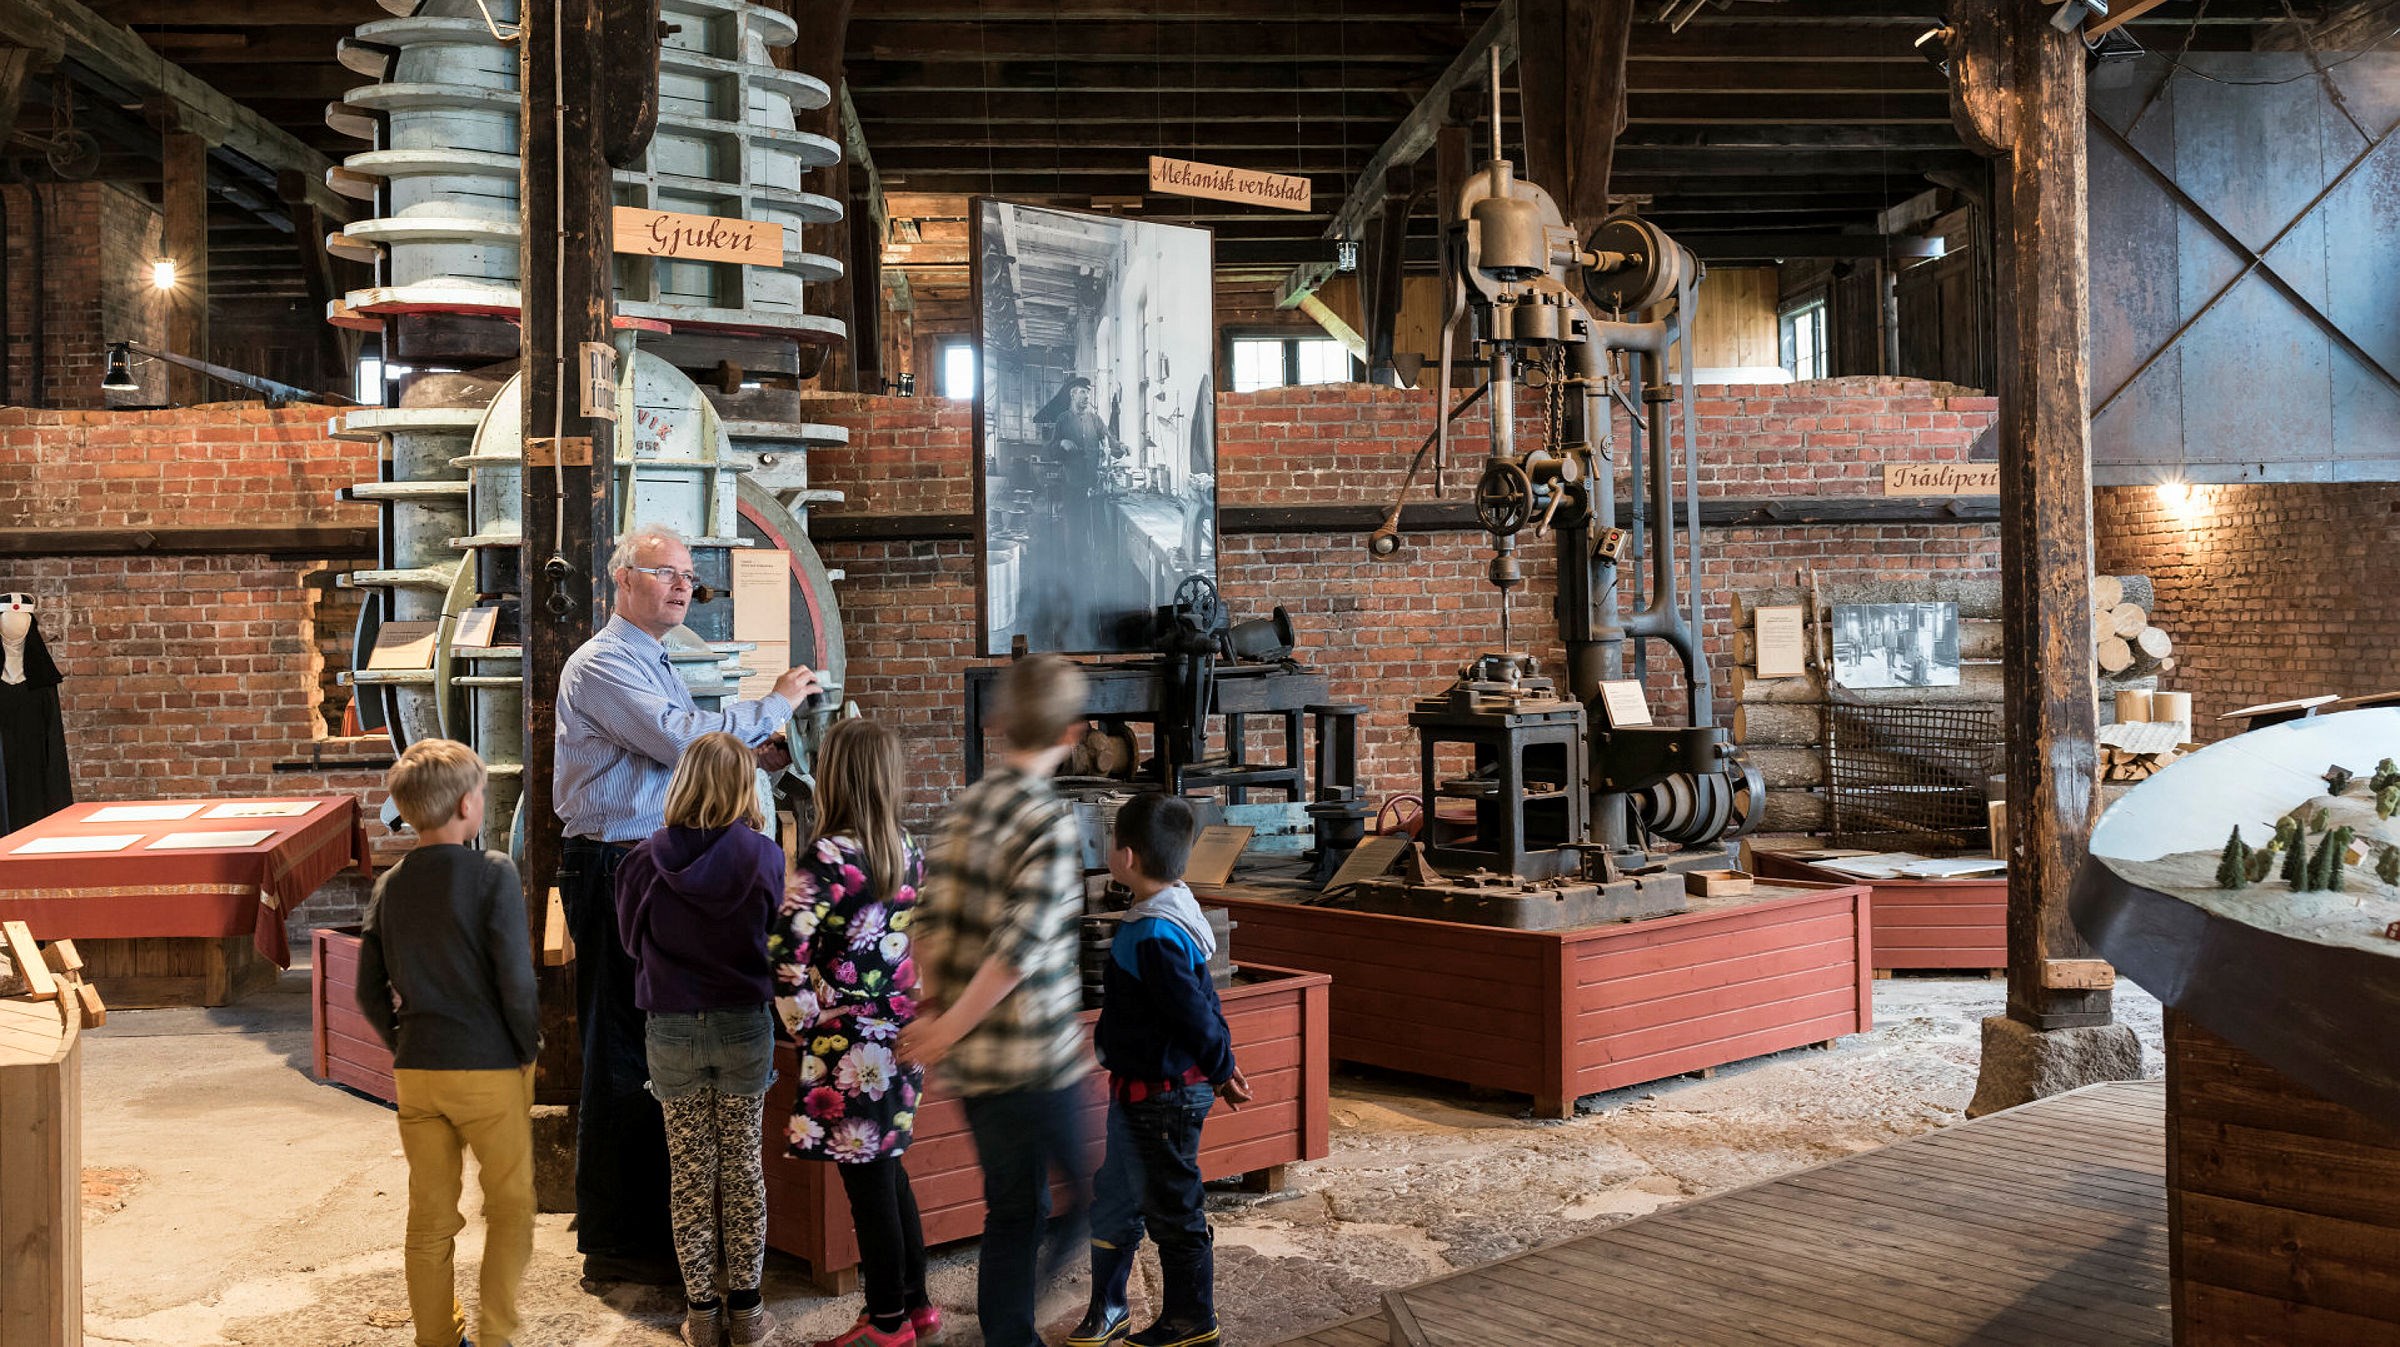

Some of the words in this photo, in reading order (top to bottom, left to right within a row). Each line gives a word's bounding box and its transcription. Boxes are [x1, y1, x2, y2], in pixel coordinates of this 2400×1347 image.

[1153, 159, 1236, 192] Mekanisk
[1239, 175, 1308, 201] verkstad
[645, 215, 756, 255] Gjuteri
[1893, 465, 1999, 494] Träsliperi
